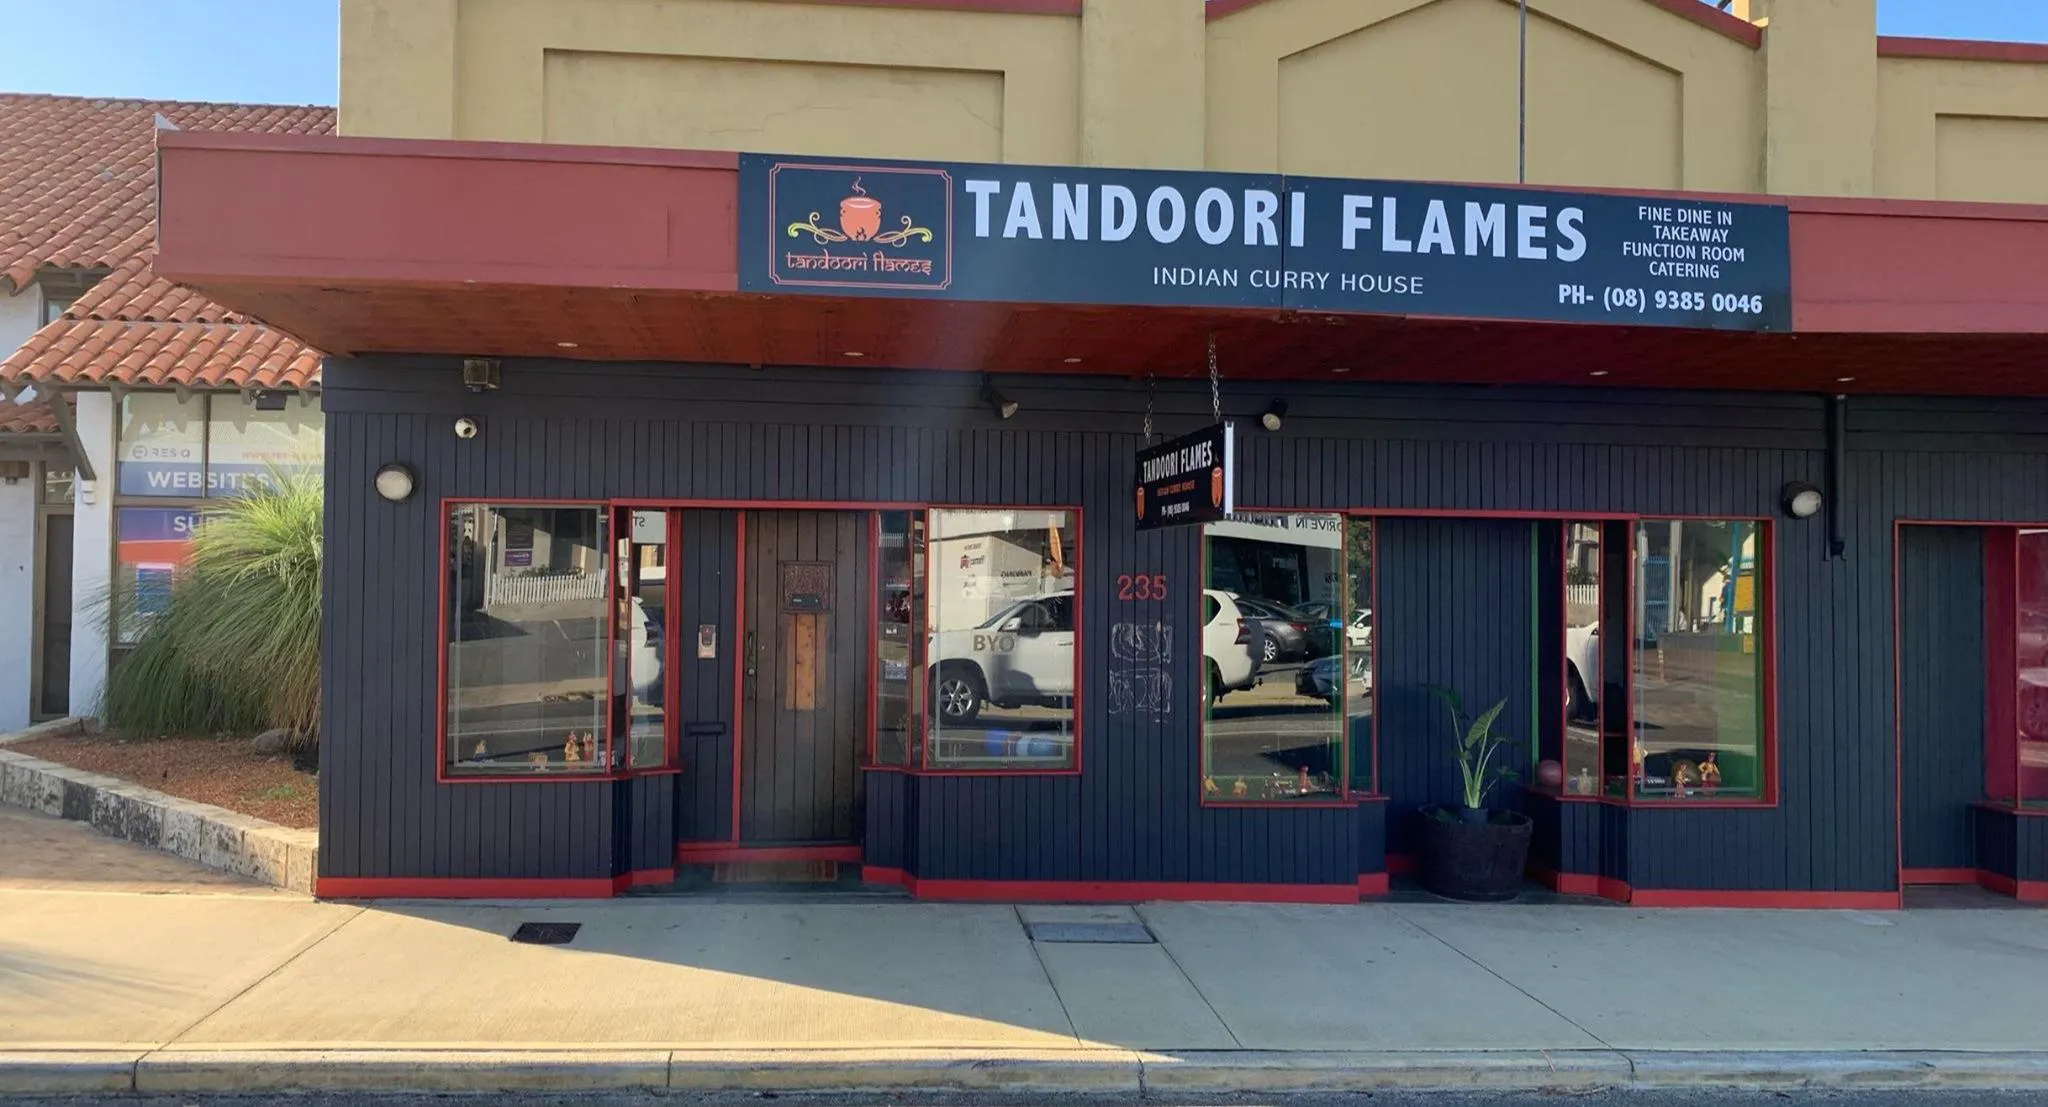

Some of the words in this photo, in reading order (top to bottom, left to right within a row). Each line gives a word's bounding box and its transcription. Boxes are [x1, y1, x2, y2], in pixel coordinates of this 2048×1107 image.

[965, 179, 1306, 247] TANDOORI
[1342, 194, 1587, 262] FLAMES
[1638, 206, 1672, 222] FINE
[1677, 208, 1712, 225] DINE
[1717, 211, 1732, 226] IN
[1653, 225, 1729, 243] TAKEAWAY
[785, 249, 868, 271] tandoori
[873, 250, 933, 275] flames
[1623, 242, 1696, 259] FUNCTION
[1702, 246, 1745, 262] ROOM
[1153, 267, 1238, 287] INDIAN
[1250, 270, 1330, 290] CURRY
[1342, 273, 1424, 295] HOUSE
[1649, 261, 1720, 279] CATERING
[1559, 284, 1594, 306] PH-
[1603, 286, 1646, 313] (08)
[1654, 290, 1706, 312] 9385
[1711, 293, 1763, 314] 0046
[1143, 451, 1179, 484] TANDOORI
[1180, 440, 1213, 474] FLAMES
[1117, 575, 1168, 601] 235
[972, 634, 1016, 652] BYO
